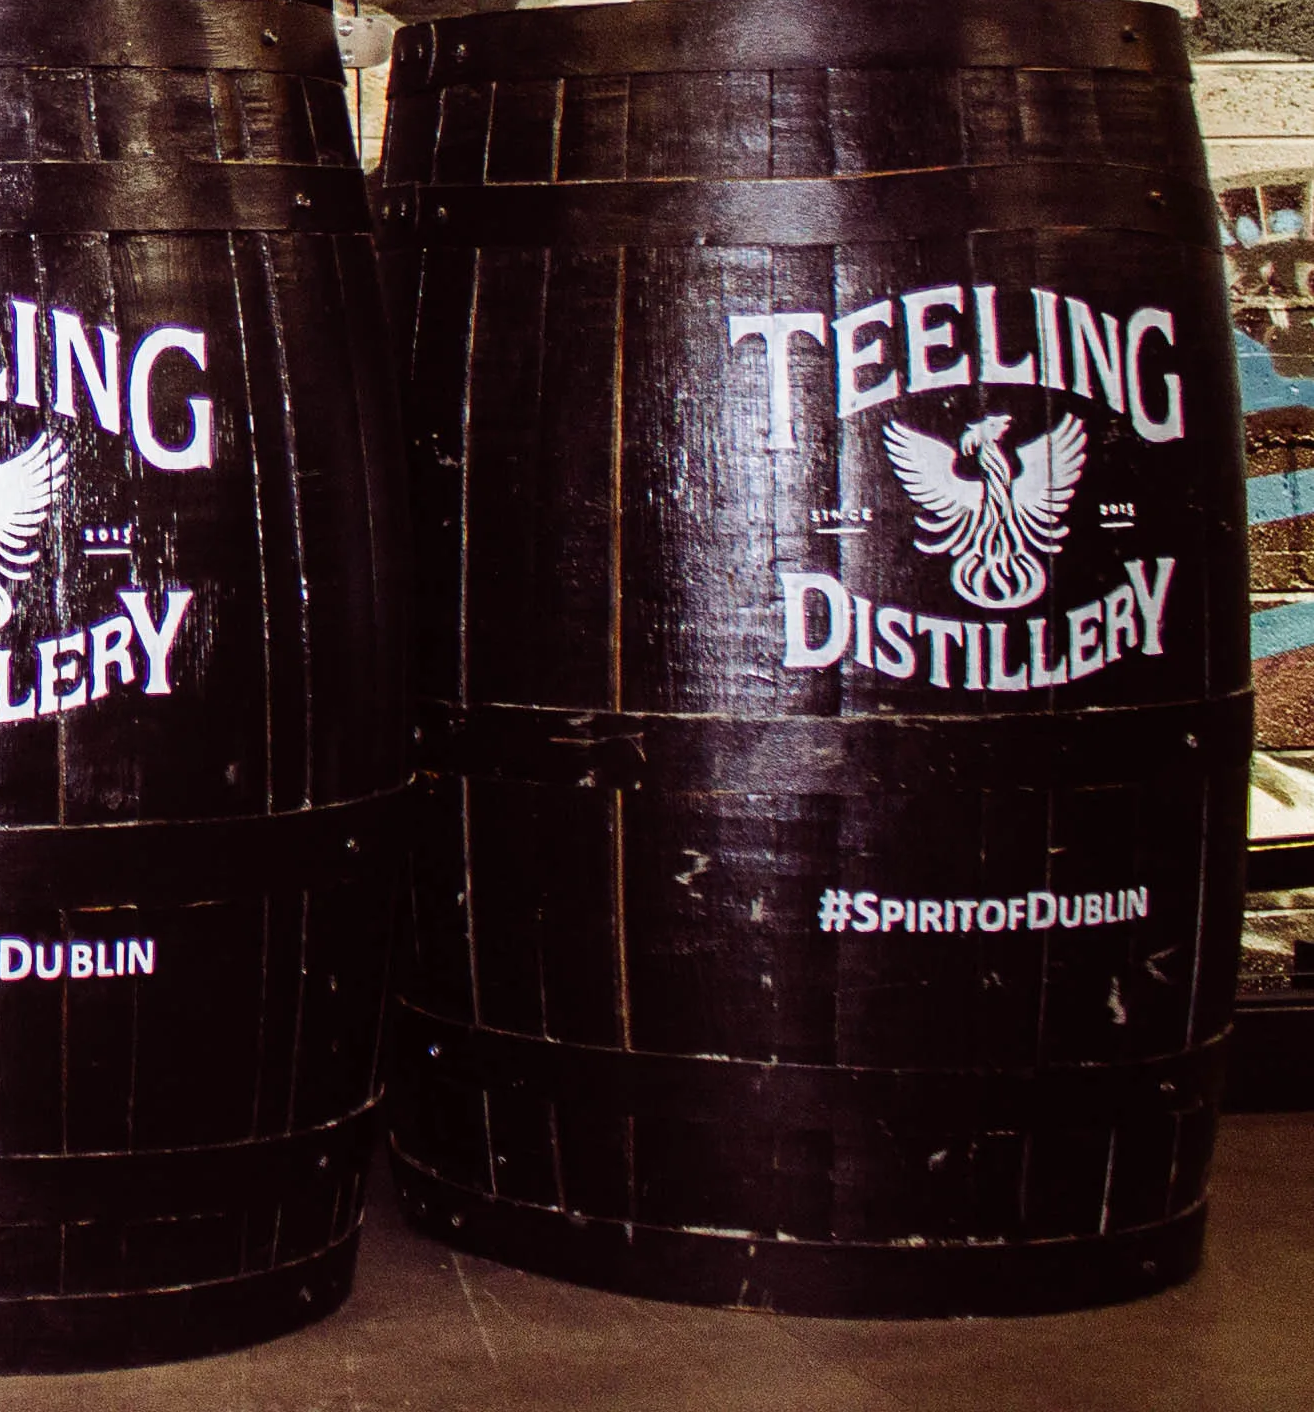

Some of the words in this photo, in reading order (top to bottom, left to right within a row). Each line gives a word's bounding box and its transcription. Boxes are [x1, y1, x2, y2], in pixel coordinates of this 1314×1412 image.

[728, 284, 1184, 451] TEELING
[84, 527, 133, 544] 2015
[810, 506, 873, 522] SINCE
[779, 557, 1176, 691] DISTILLERY
